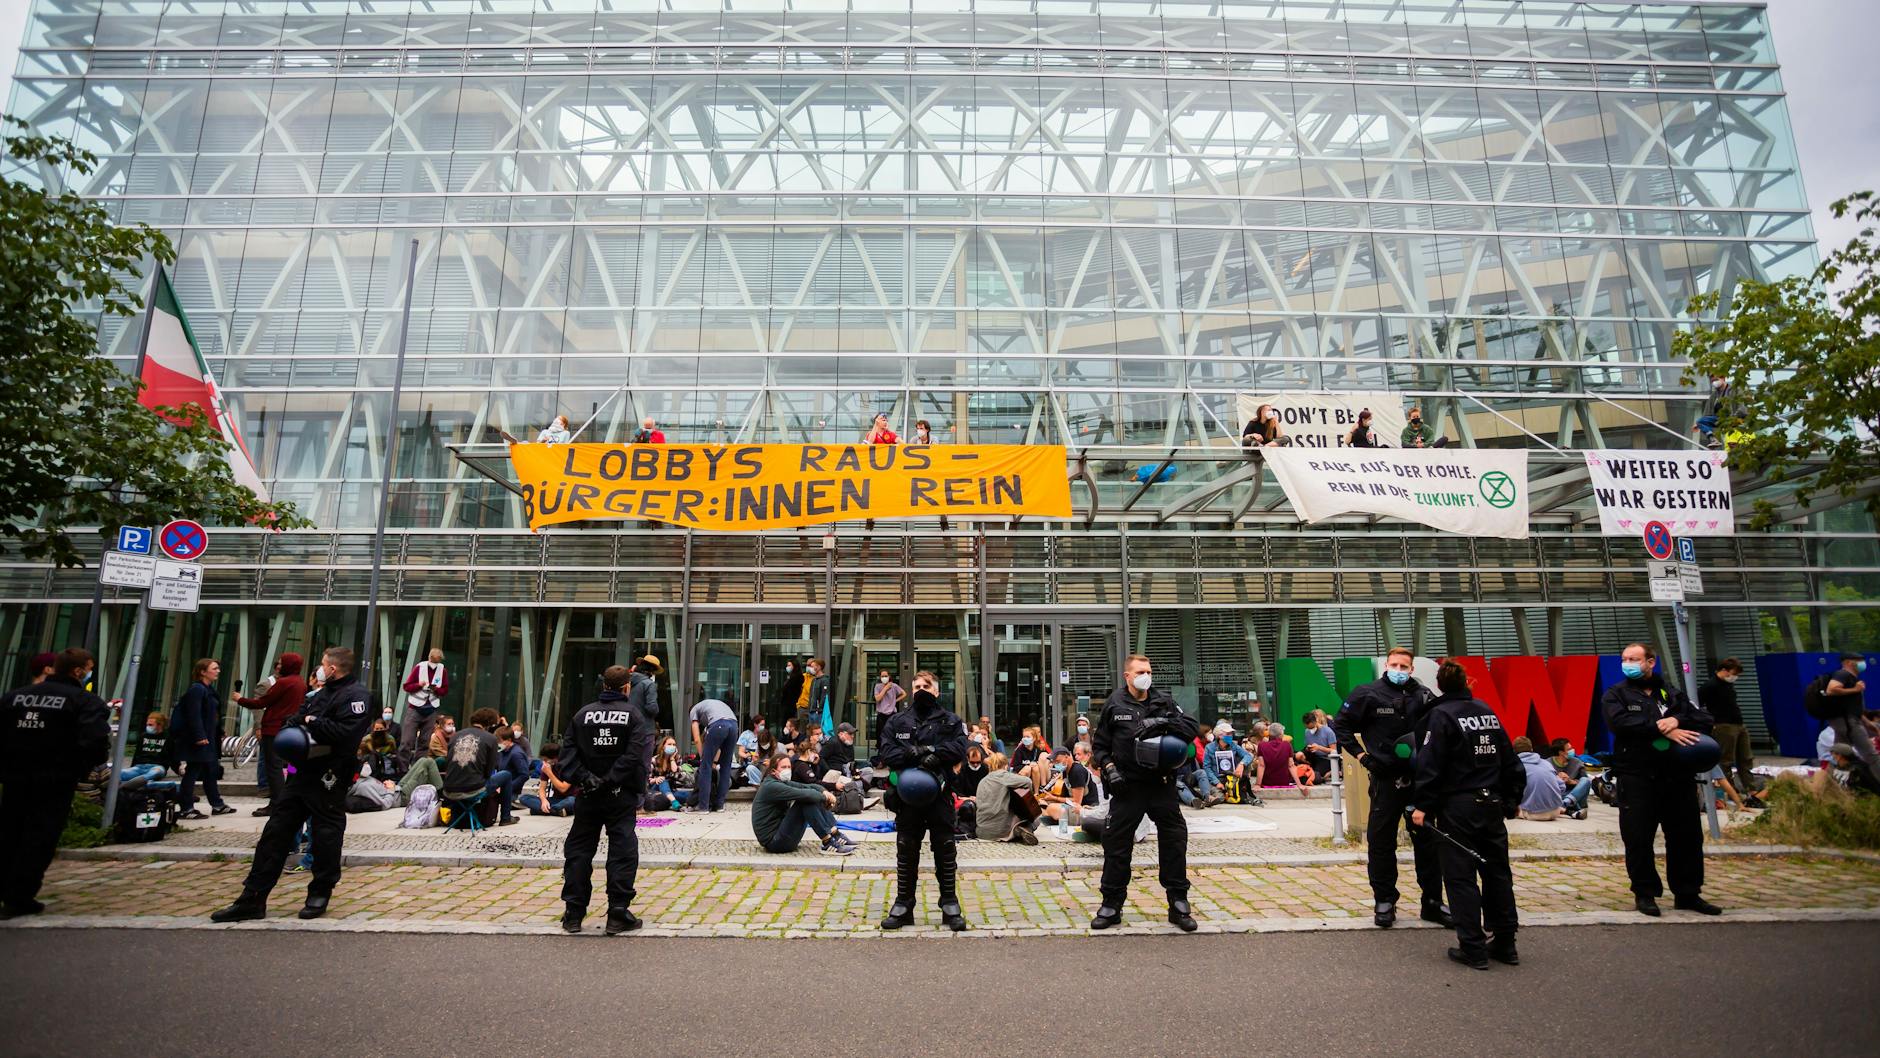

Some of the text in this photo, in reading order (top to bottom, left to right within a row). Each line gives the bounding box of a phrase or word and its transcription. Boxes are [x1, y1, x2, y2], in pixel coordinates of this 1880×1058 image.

[1271, 407, 1355, 424] DON'T BE
[563, 447, 763, 481] LOBBYS
[799, 445, 931, 472] RAUS
[1308, 460, 1477, 480] RAUS AUS DER KOHLE.
[1606, 459, 1712, 480] WEITER SO
[522, 474, 1024, 522] BÜRGER:INNEN REIN
[1328, 482, 1479, 507] REIN IN DIE ZUKUNFT.
[1596, 488, 1731, 510] WAR GESTERN
[123, 529, 142, 549] P
[12, 694, 66, 709] POLIZEI
[25, 711, 39, 720] BE
[583, 711, 630, 725] POLIZEI
[16, 719, 45, 729] 36124
[599, 728, 611, 737] BE
[1479, 735, 1490, 744] BE
[592, 736, 618, 746] 36127
[1474, 744, 1497, 755] 36105
